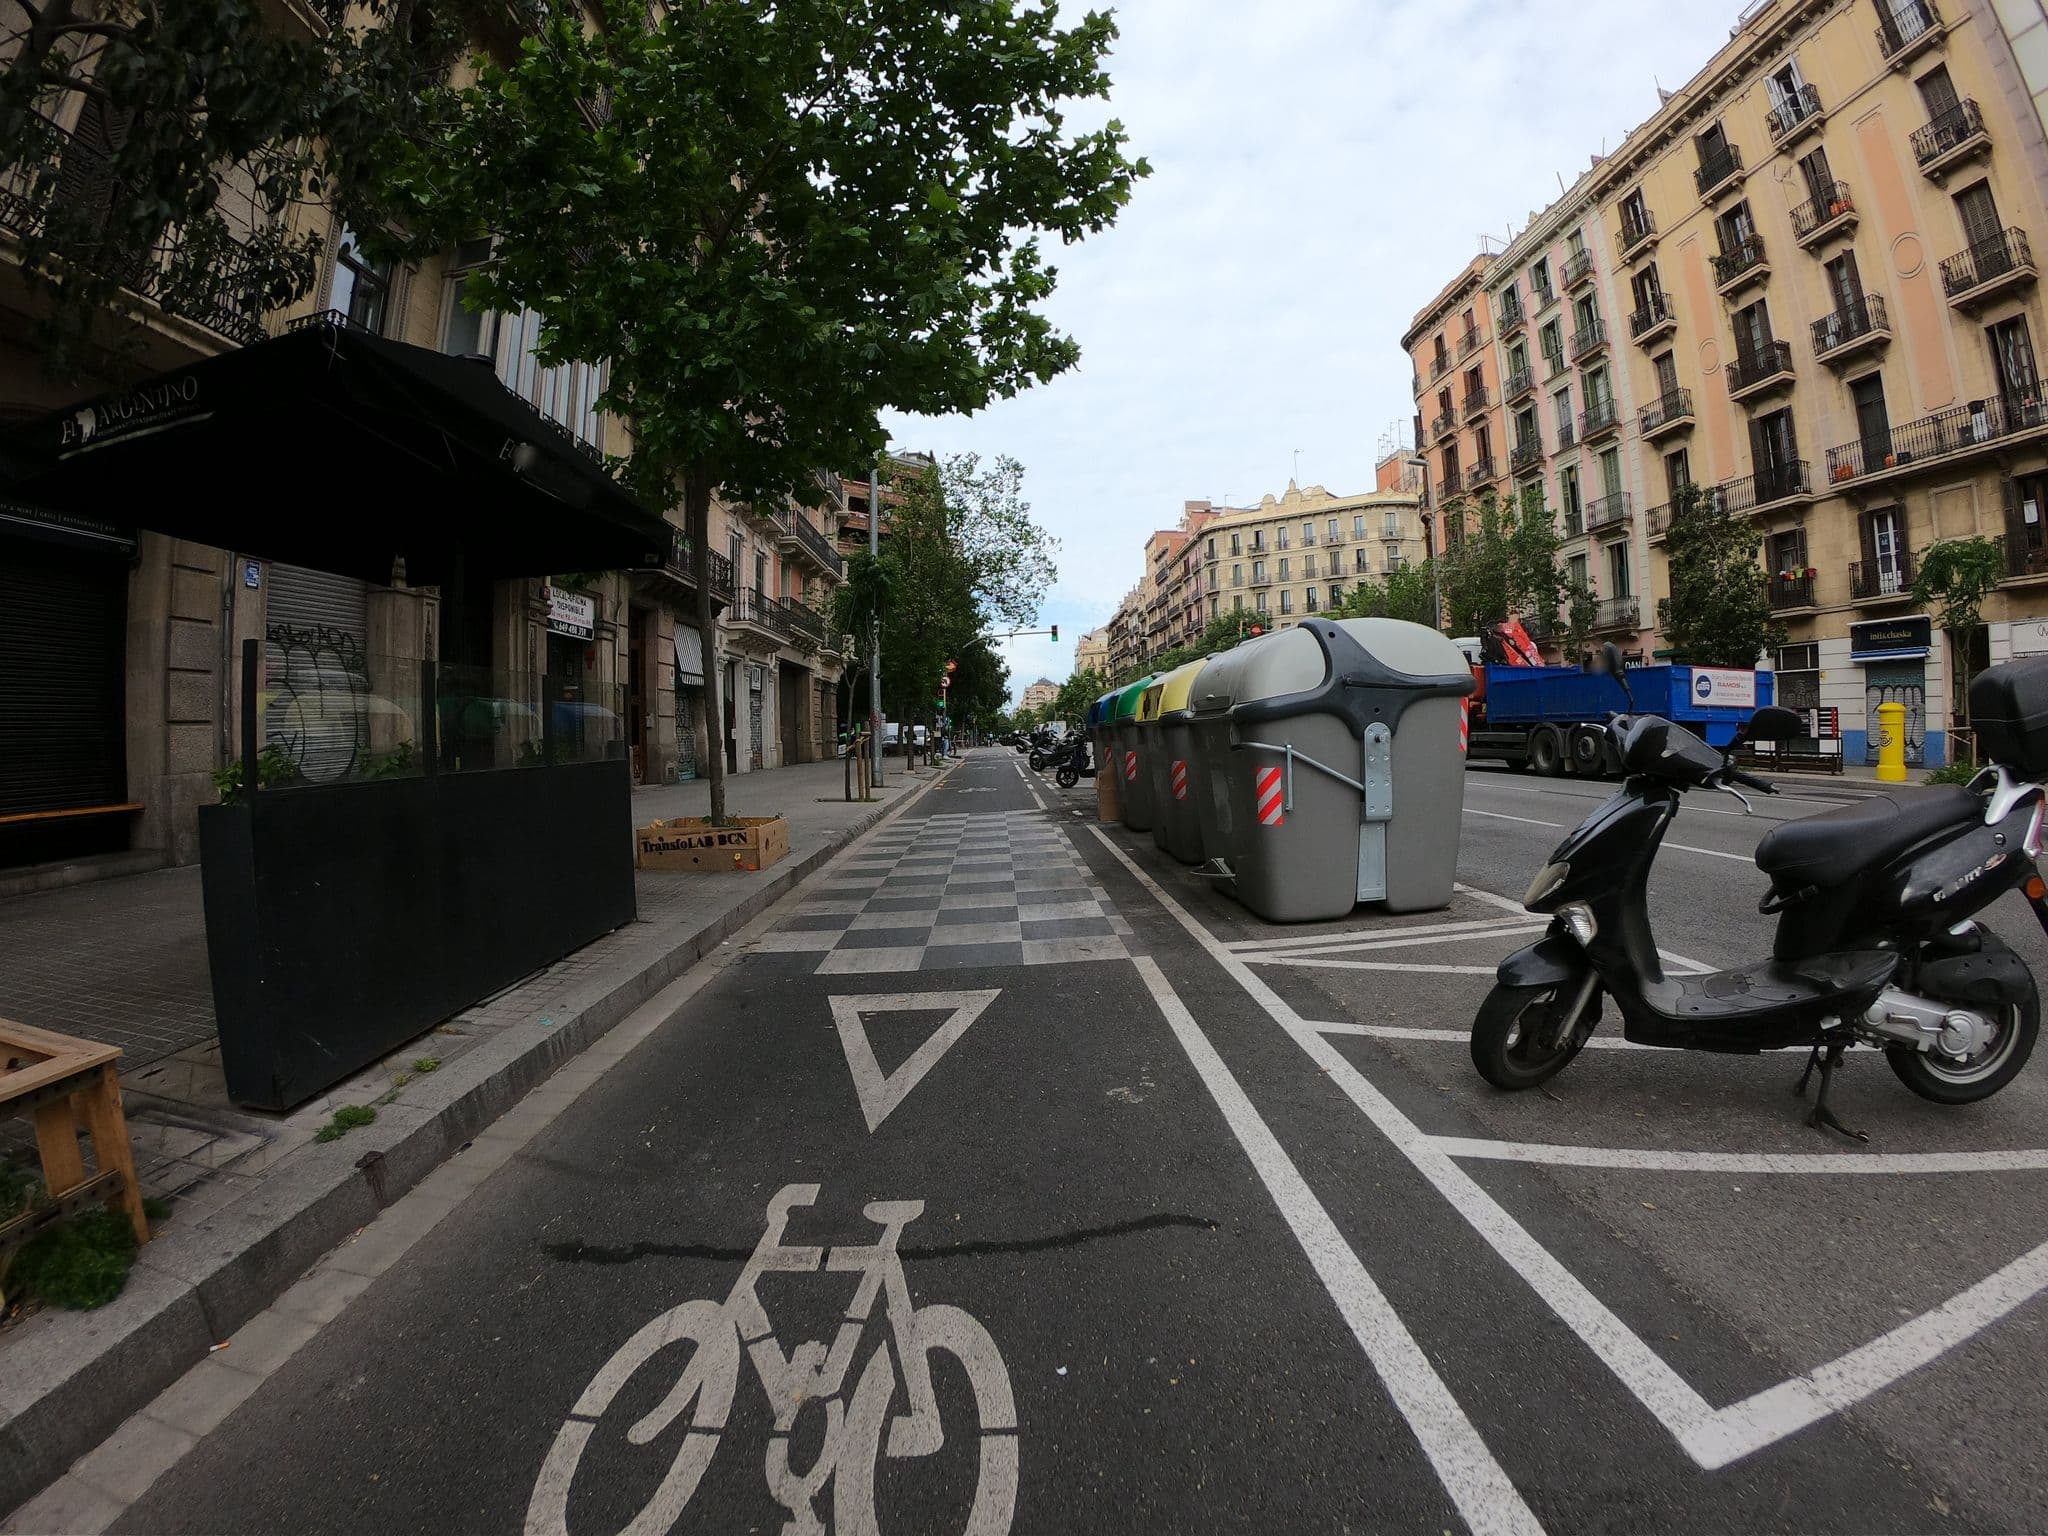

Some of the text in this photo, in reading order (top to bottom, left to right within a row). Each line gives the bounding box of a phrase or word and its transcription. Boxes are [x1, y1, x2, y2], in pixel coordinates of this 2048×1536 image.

[100, 375, 198, 425] ARGENTINO
[1717, 681, 1740, 689] RAMOS
[642, 832, 748, 853] TransfoLAB BCN
